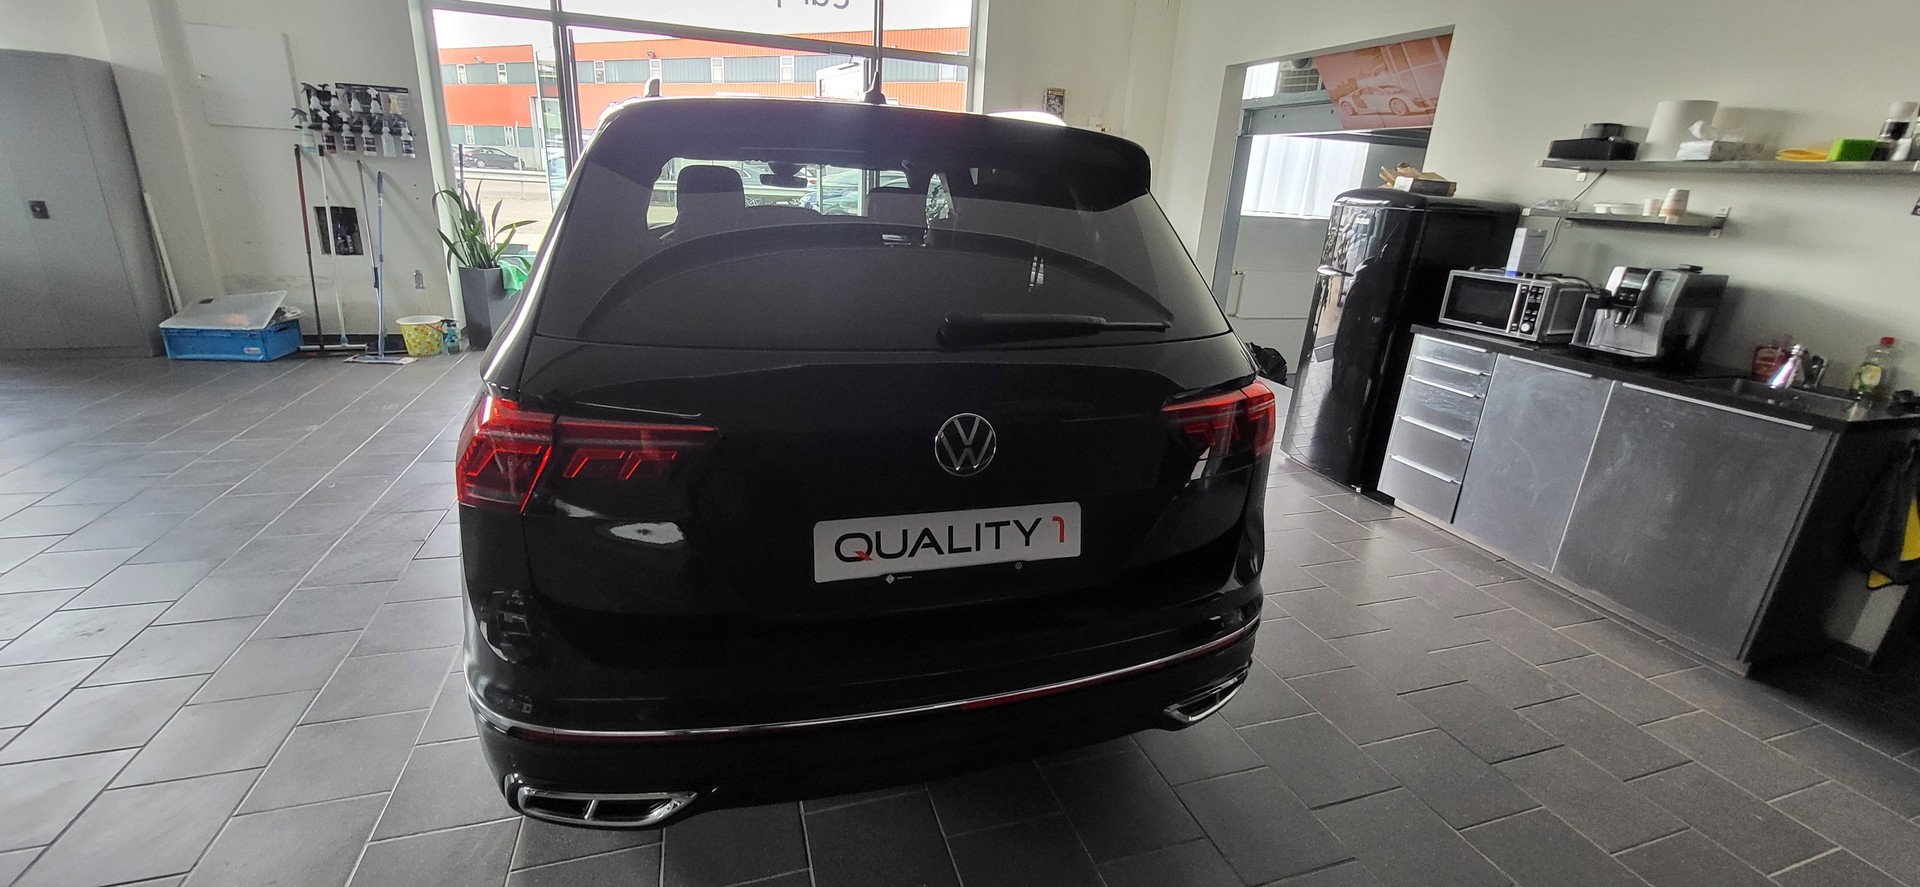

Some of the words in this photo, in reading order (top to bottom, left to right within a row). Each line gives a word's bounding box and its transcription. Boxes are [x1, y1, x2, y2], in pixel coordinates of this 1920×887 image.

[935, 413, 997, 476] VW
[834, 517, 1042, 563] QUALITY
[1051, 515, 1065, 543] 1
